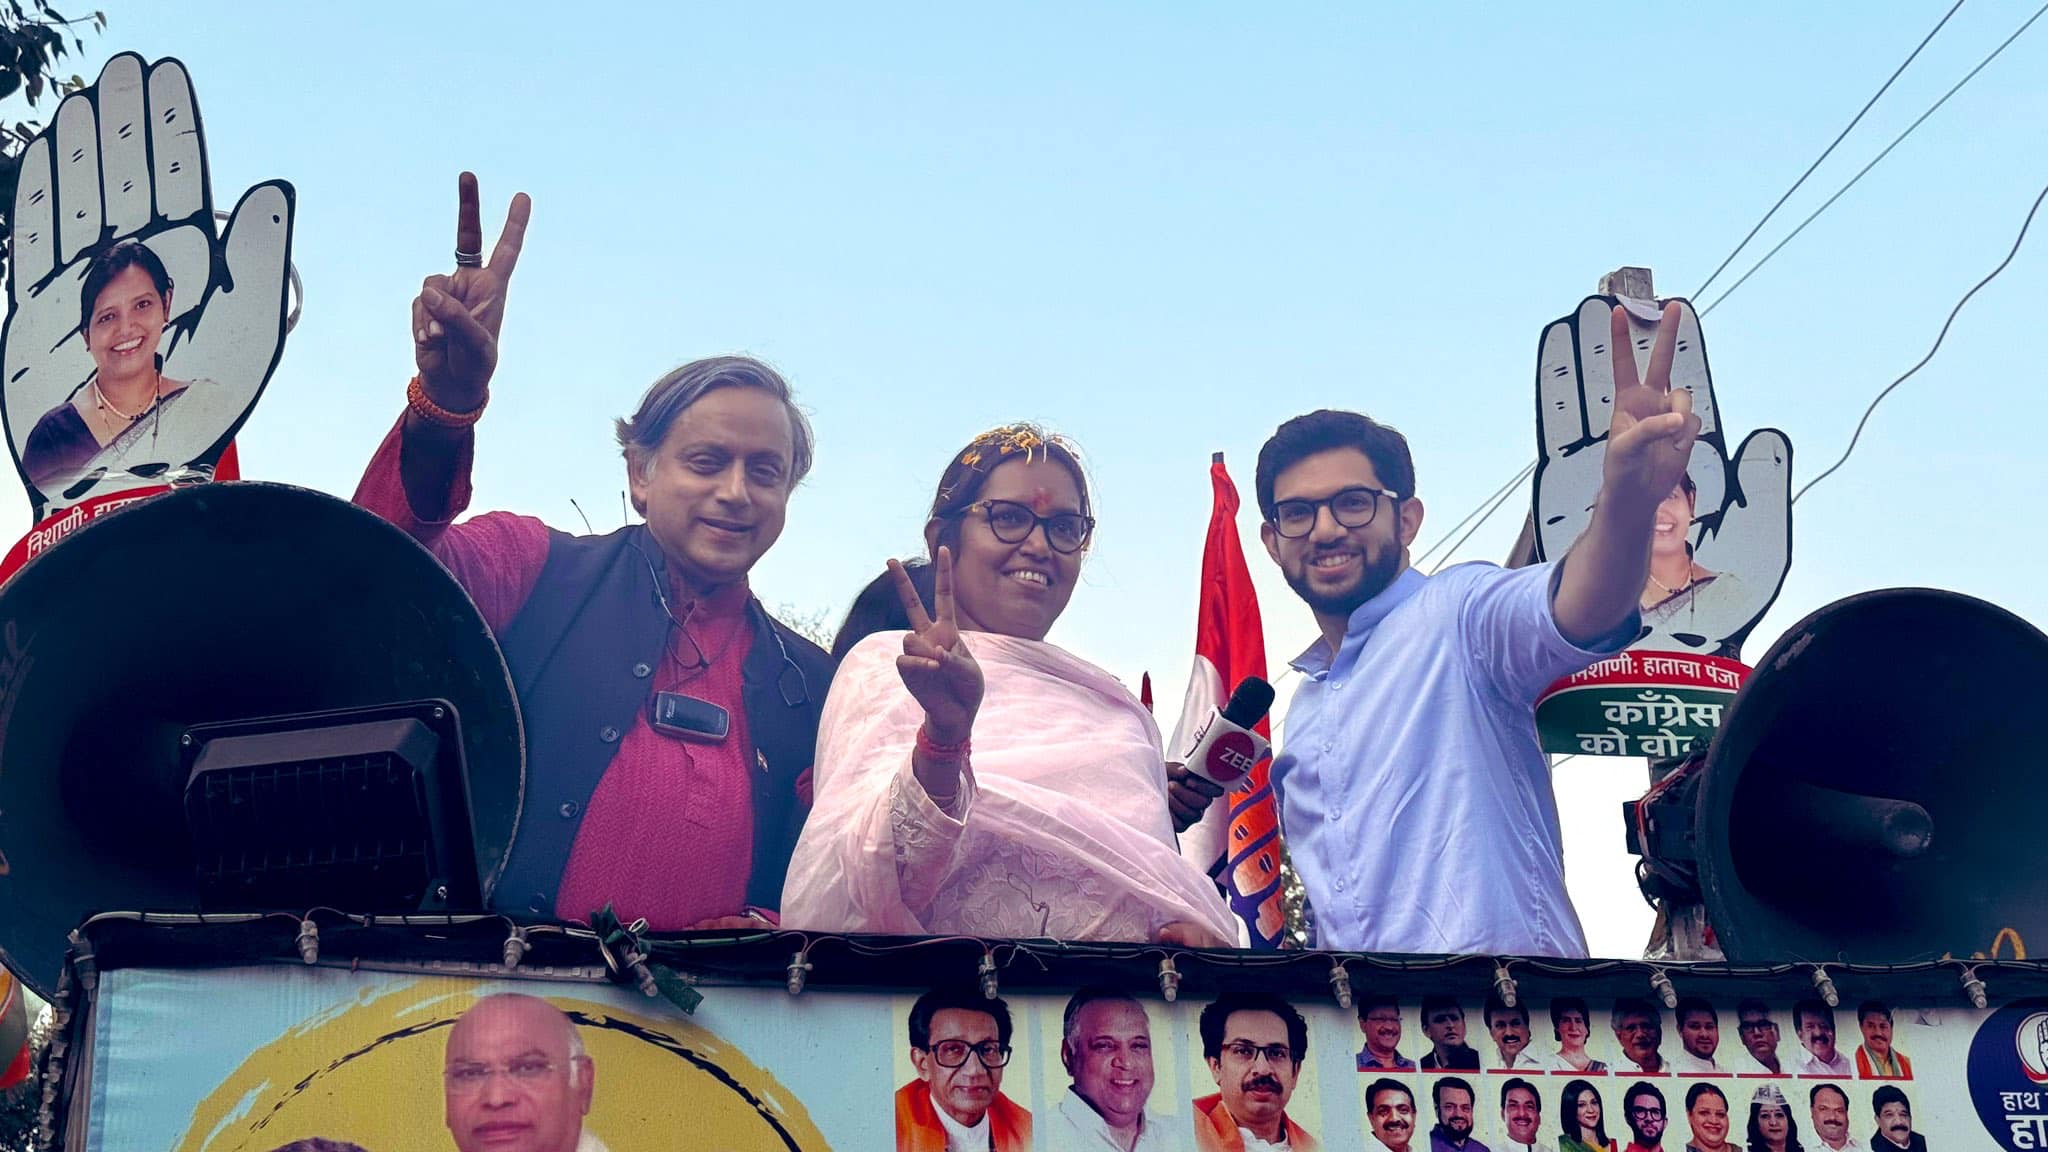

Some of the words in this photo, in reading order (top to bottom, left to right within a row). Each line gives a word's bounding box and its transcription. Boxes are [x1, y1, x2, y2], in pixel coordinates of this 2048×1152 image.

[1642, 656, 1701, 679] हाताचा
[1705, 661, 1740, 689] पंजा
[1576, 727, 1630, 756] को
[1637, 728, 1696, 757] वो
[1219, 746, 1253, 774] ZEE
[2000, 1091, 2040, 1111] हाथ
